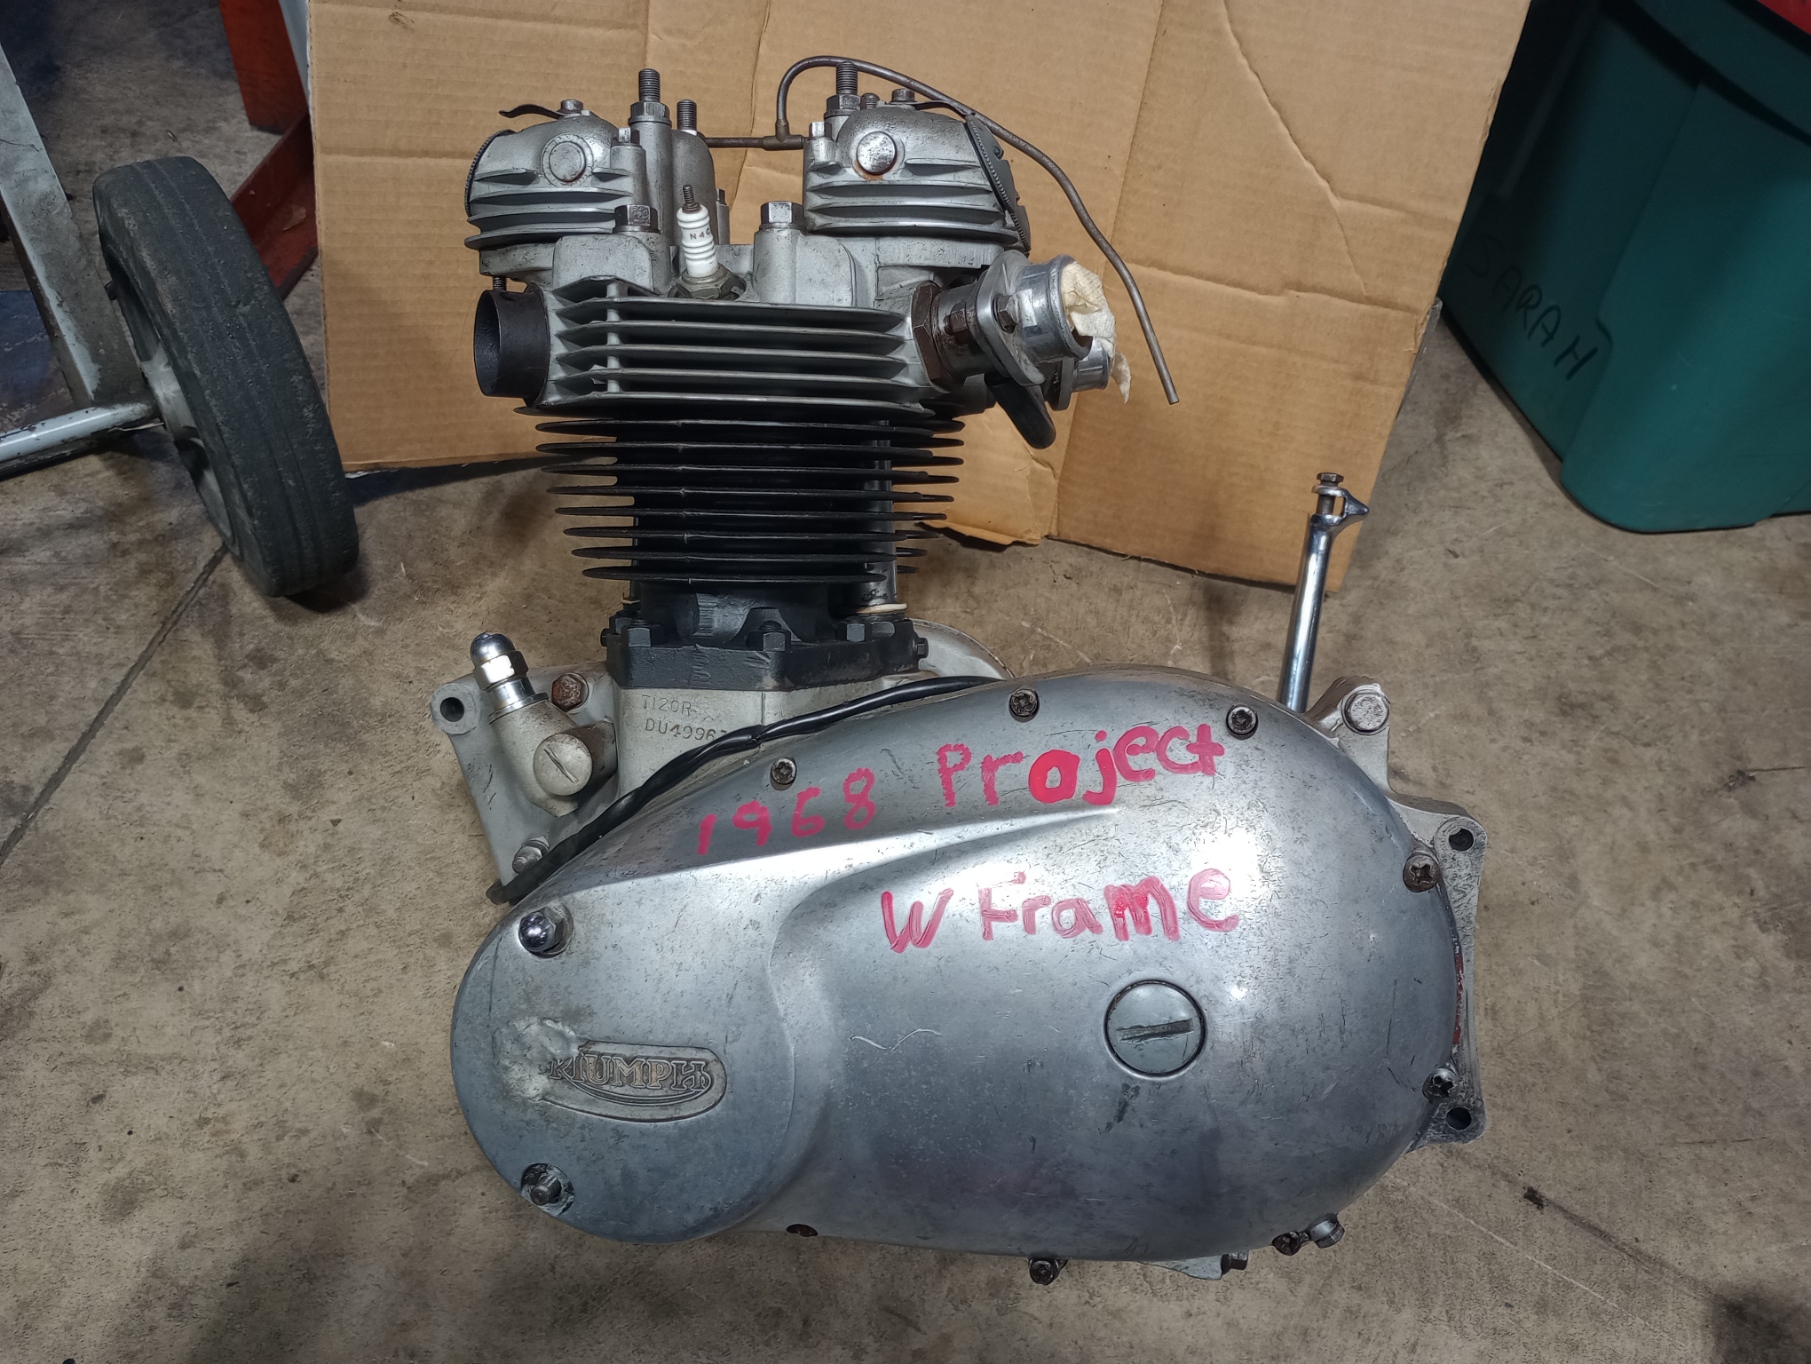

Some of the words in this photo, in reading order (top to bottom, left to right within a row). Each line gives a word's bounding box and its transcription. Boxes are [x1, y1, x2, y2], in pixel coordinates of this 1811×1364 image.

[1463, 233, 1599, 381] SARAH
[697, 768, 876, 855] 1968
[936, 724, 1225, 806] Project
[880, 888, 954, 954] W
[979, 868, 1240, 941] Frame
